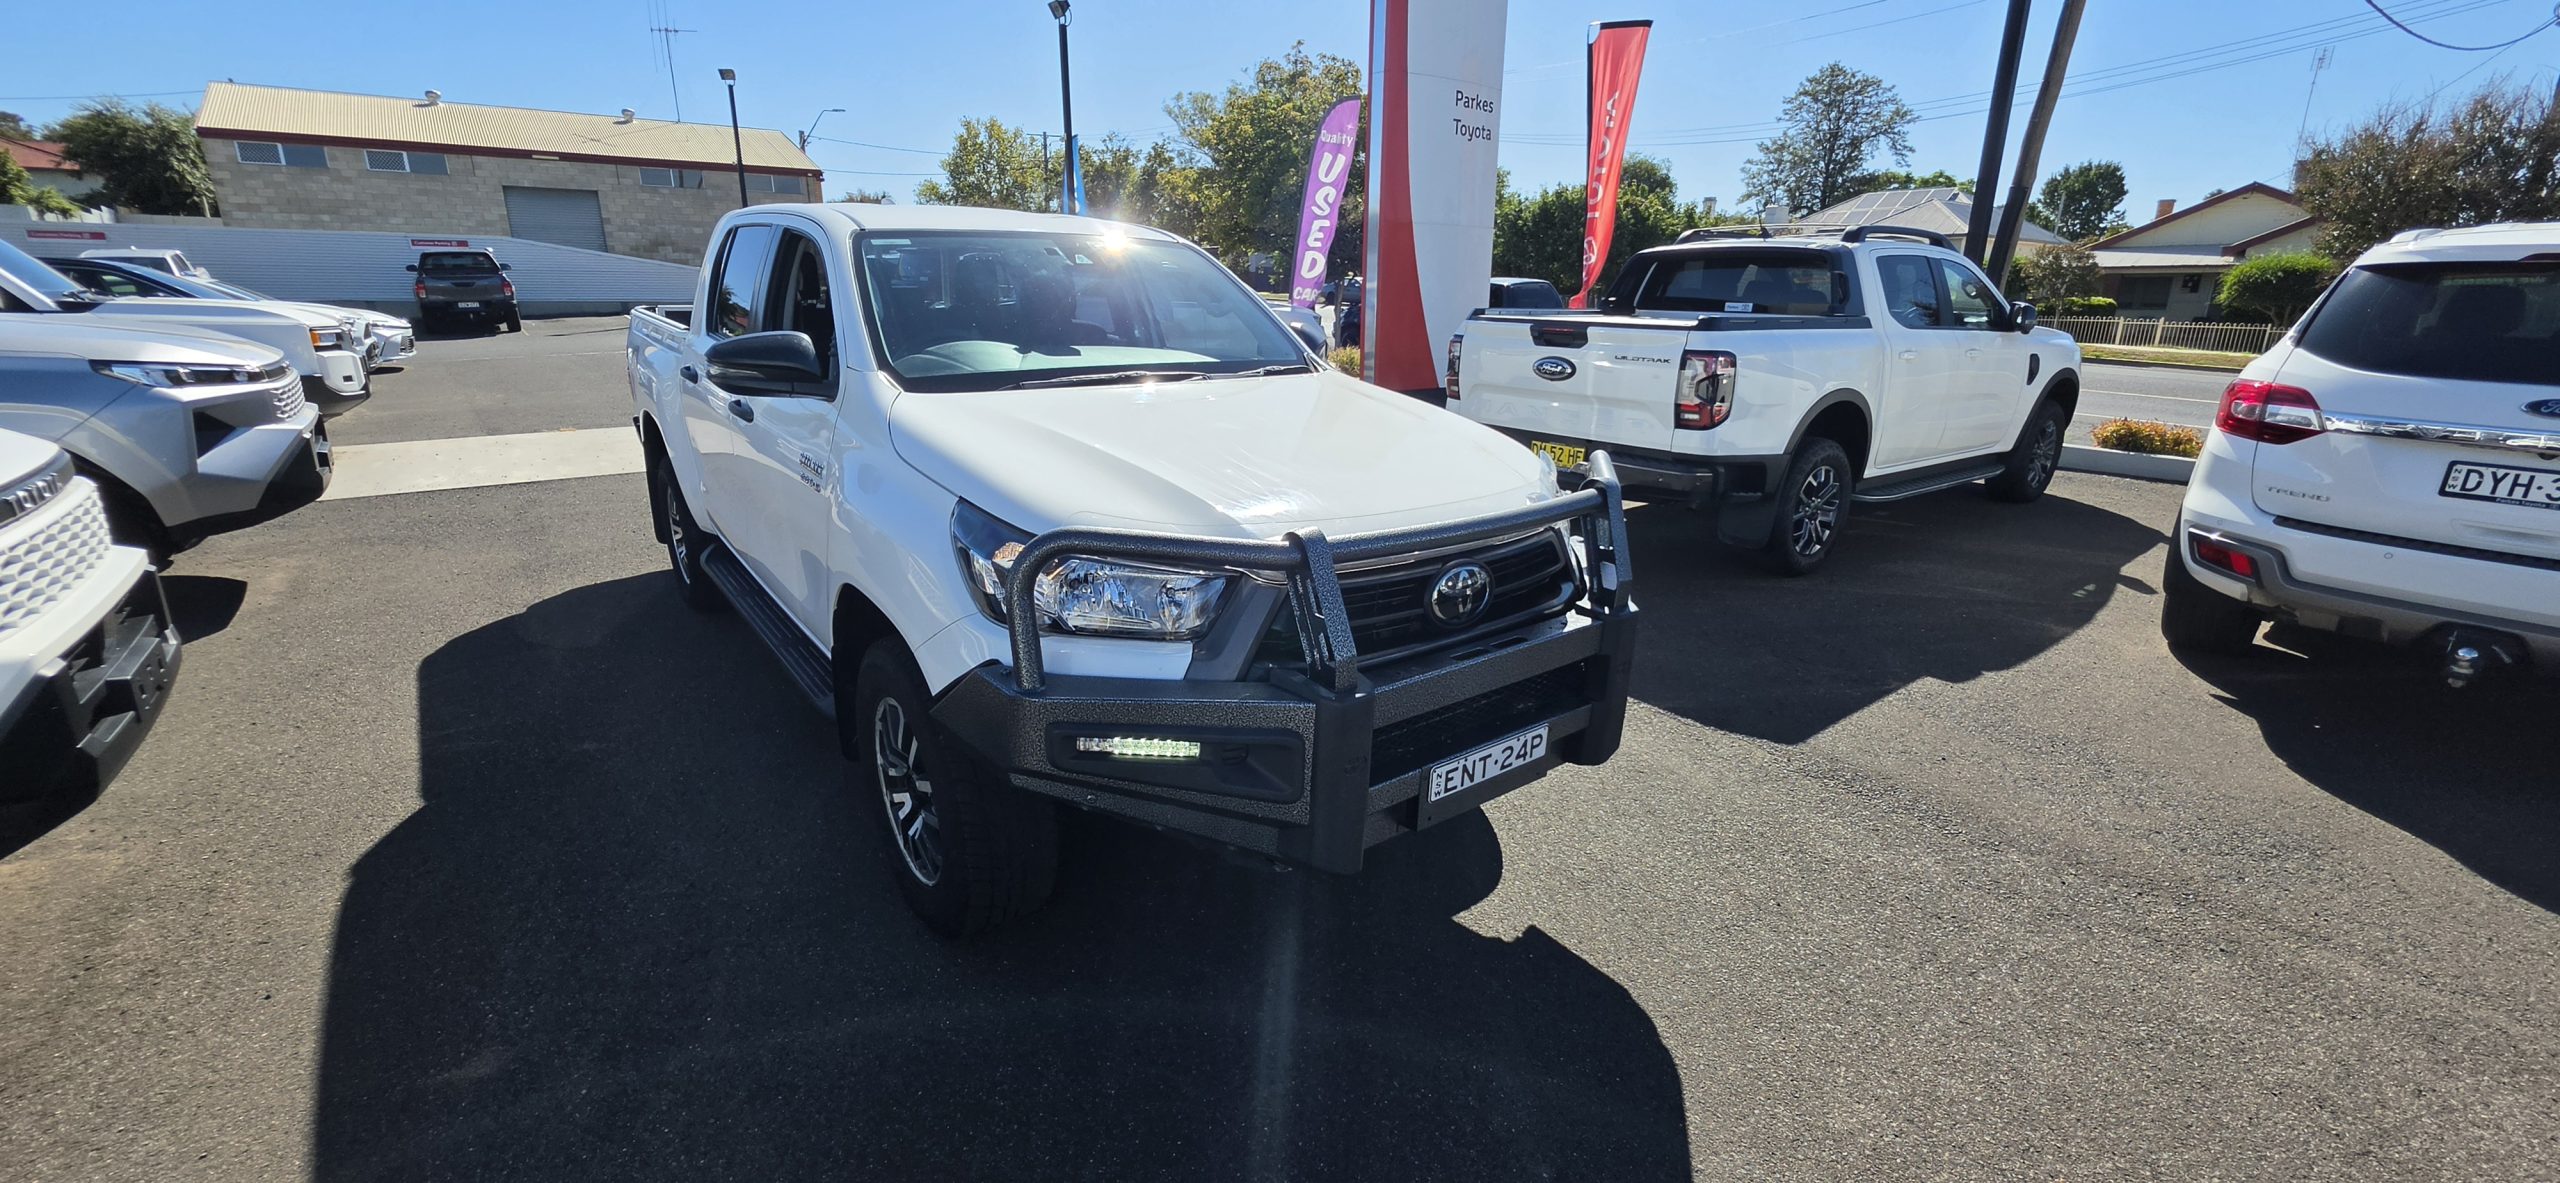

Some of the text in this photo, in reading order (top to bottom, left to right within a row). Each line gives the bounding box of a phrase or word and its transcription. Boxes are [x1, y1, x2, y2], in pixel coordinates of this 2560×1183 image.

[1455, 89, 1494, 113] Parkes
[1320, 129, 1354, 148] Quality
[1452, 118, 1492, 142] Toyota
[1300, 151, 1347, 279] USED
